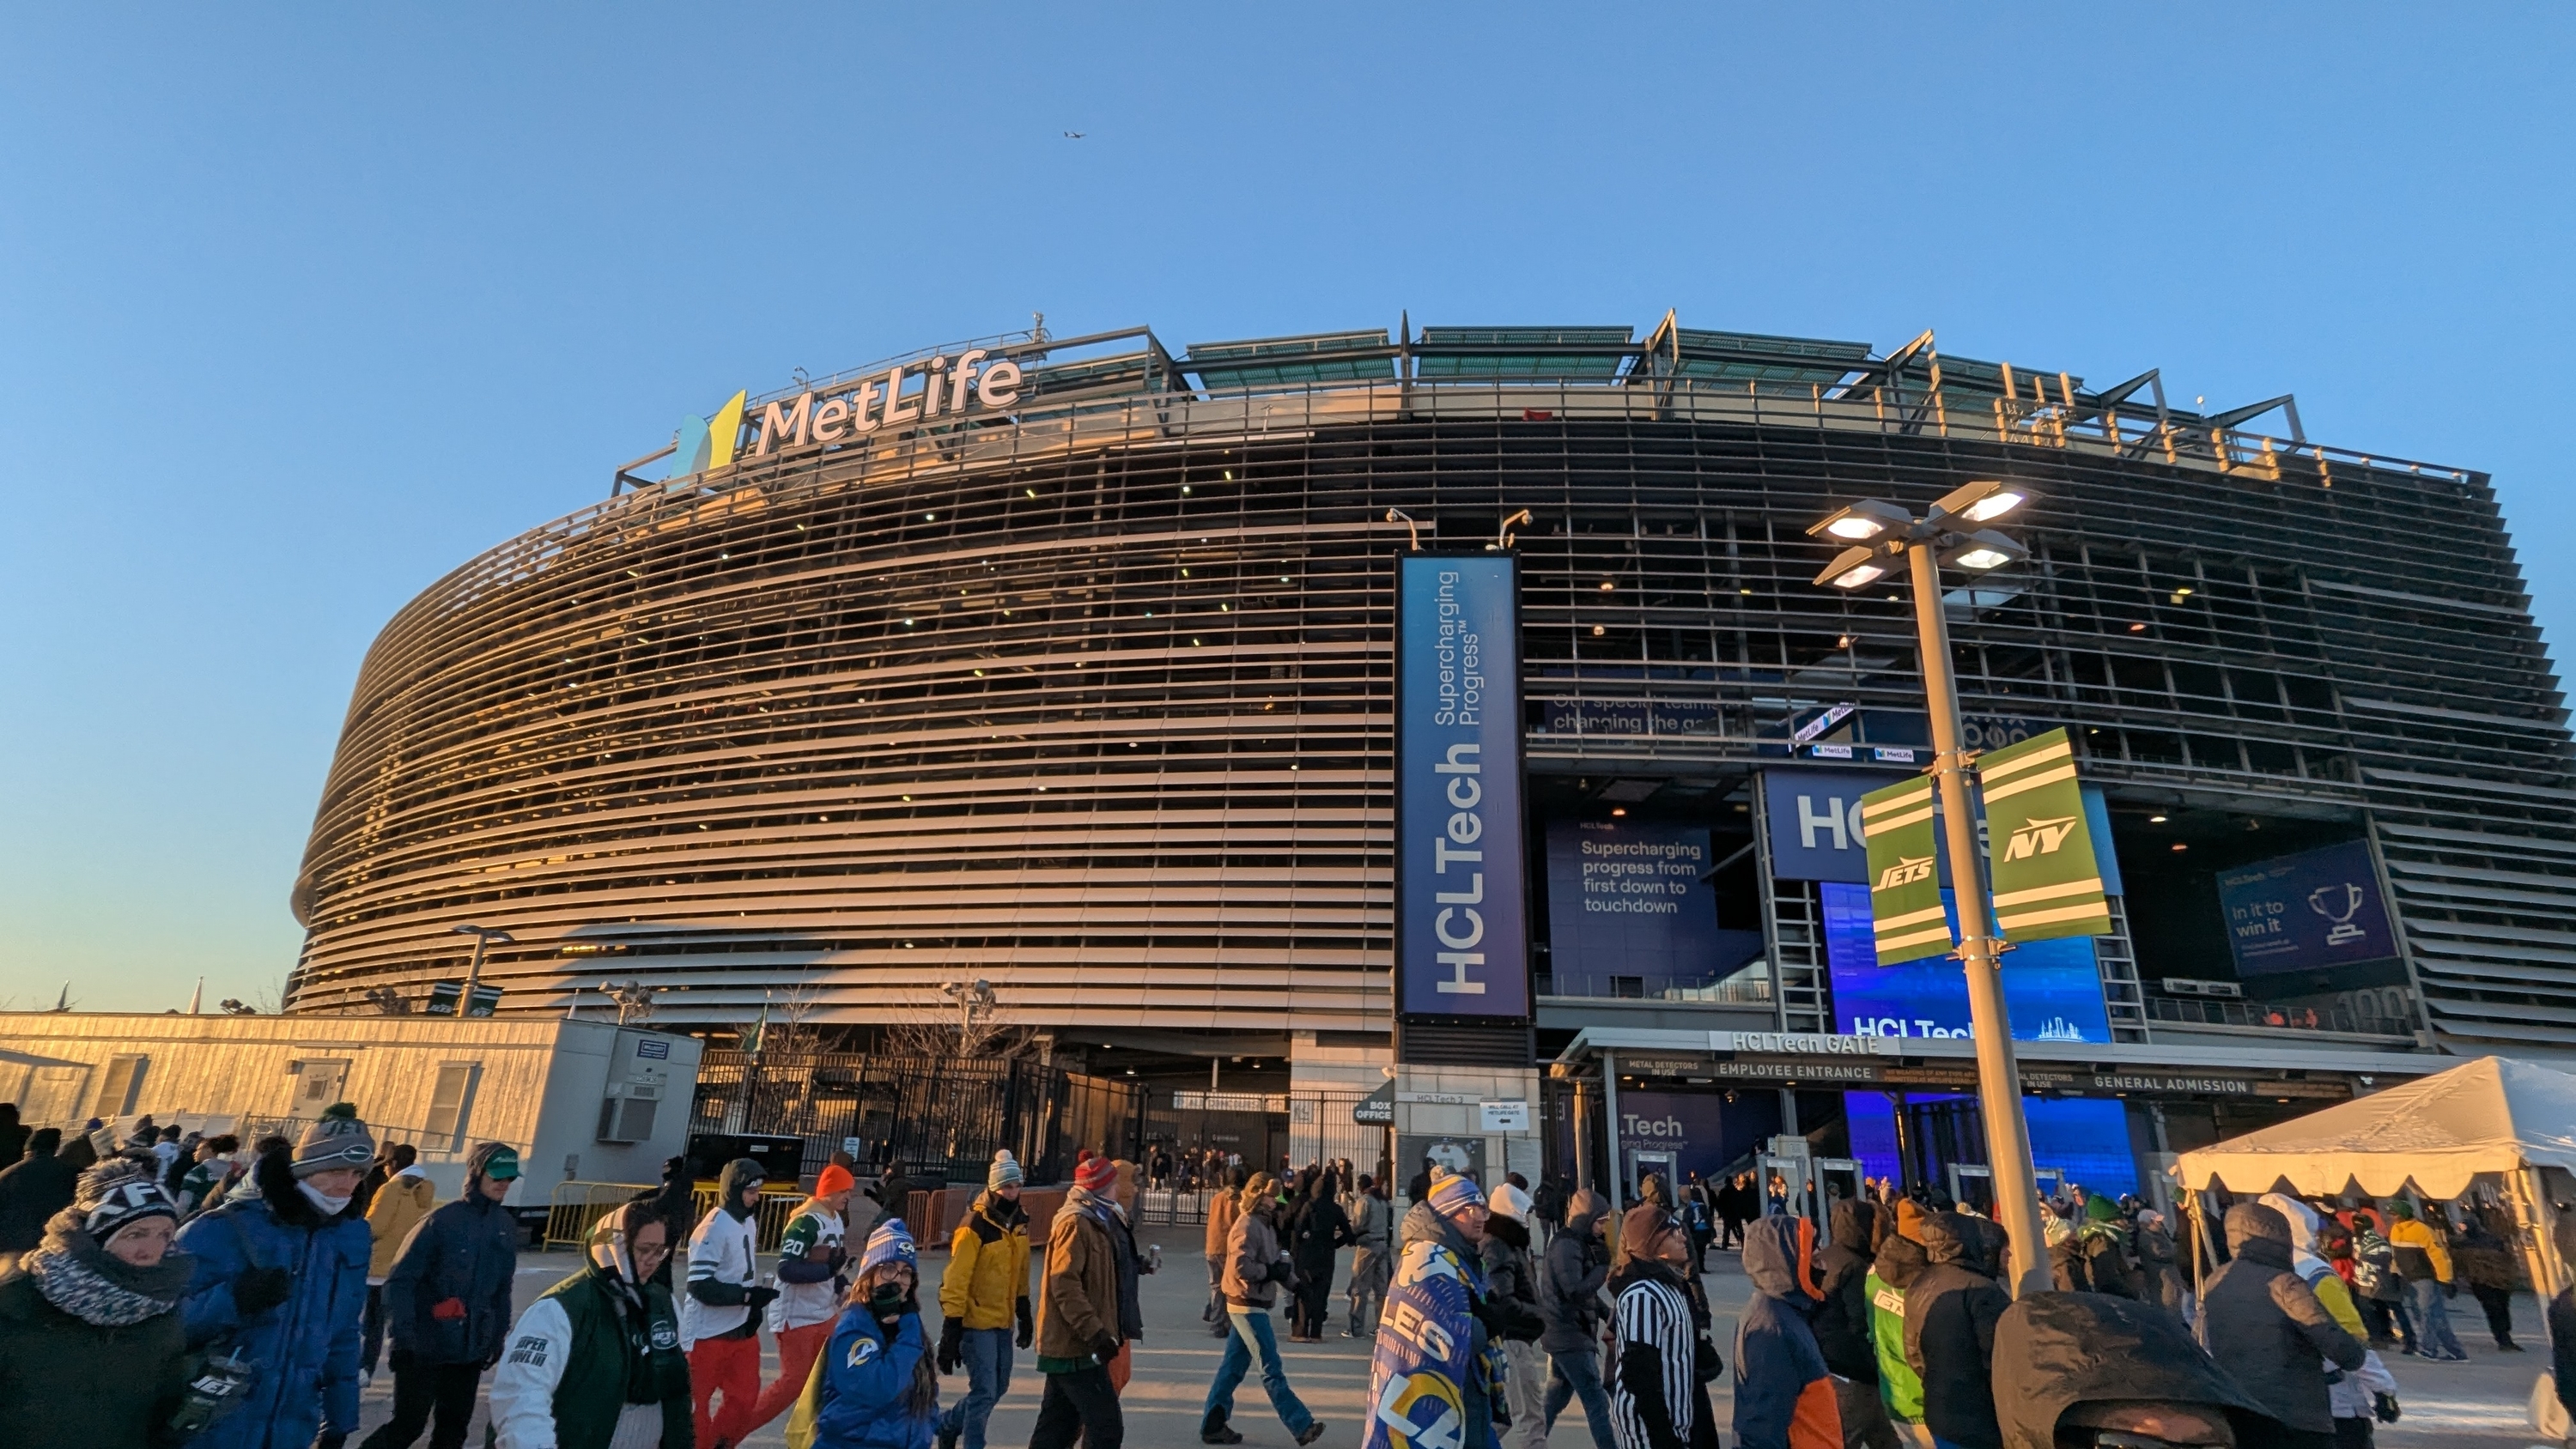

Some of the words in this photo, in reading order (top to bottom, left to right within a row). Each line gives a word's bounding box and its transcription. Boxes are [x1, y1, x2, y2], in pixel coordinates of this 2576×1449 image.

[755, 349, 1024, 458] MetLife
[1434, 572, 1459, 726] Supercharging
[1650, 713, 1679, 731] he
[1796, 724, 1820, 741] MetLife
[1824, 746, 1850, 755] MetLife
[1886, 750, 1913, 759] MetLife
[2003, 816, 2077, 863] NY
[1581, 840, 1701, 860] Supercharging
[1435, 743, 1486, 995] HCLTech
[1583, 862, 1655, 877] progress
[1656, 861, 1697, 876] from
[1871, 856, 1935, 894] JETS
[1583, 878, 1617, 893] first
[1619, 878, 1665, 894] down
[1668, 881, 1686, 894] to
[1584, 897, 1678, 914] touchdown
[2232, 906, 2248, 921] In
[2250, 903, 2263, 918] it
[2265, 900, 2284, 914] to
[2235, 921, 2265, 937] win
[2268, 917, 2282, 933] it
[1733, 1031, 1820, 1052] HCLTech
[1826, 1035, 1881, 1054] GATE
[1629, 1060, 1654, 1069] METAL
[1655, 1061, 1698, 1070] DETECTORS
[1719, 1063, 1793, 1076] EMPLOYEE
[1796, 1065, 1873, 1079] ENTRANCE
[2029, 1073, 2073, 1082] DETECTORS
[2094, 1076, 2161, 1089] GENERAL
[2166, 1078, 2248, 1093] ADMISSION
[1370, 1100, 1392, 1110] BOX
[1356, 1110, 1392, 1119] OFFICE
[1621, 1114, 1683, 1137] Tech
[782, 1239, 805, 1256] 20
[742, 1234, 755, 1283] 1
